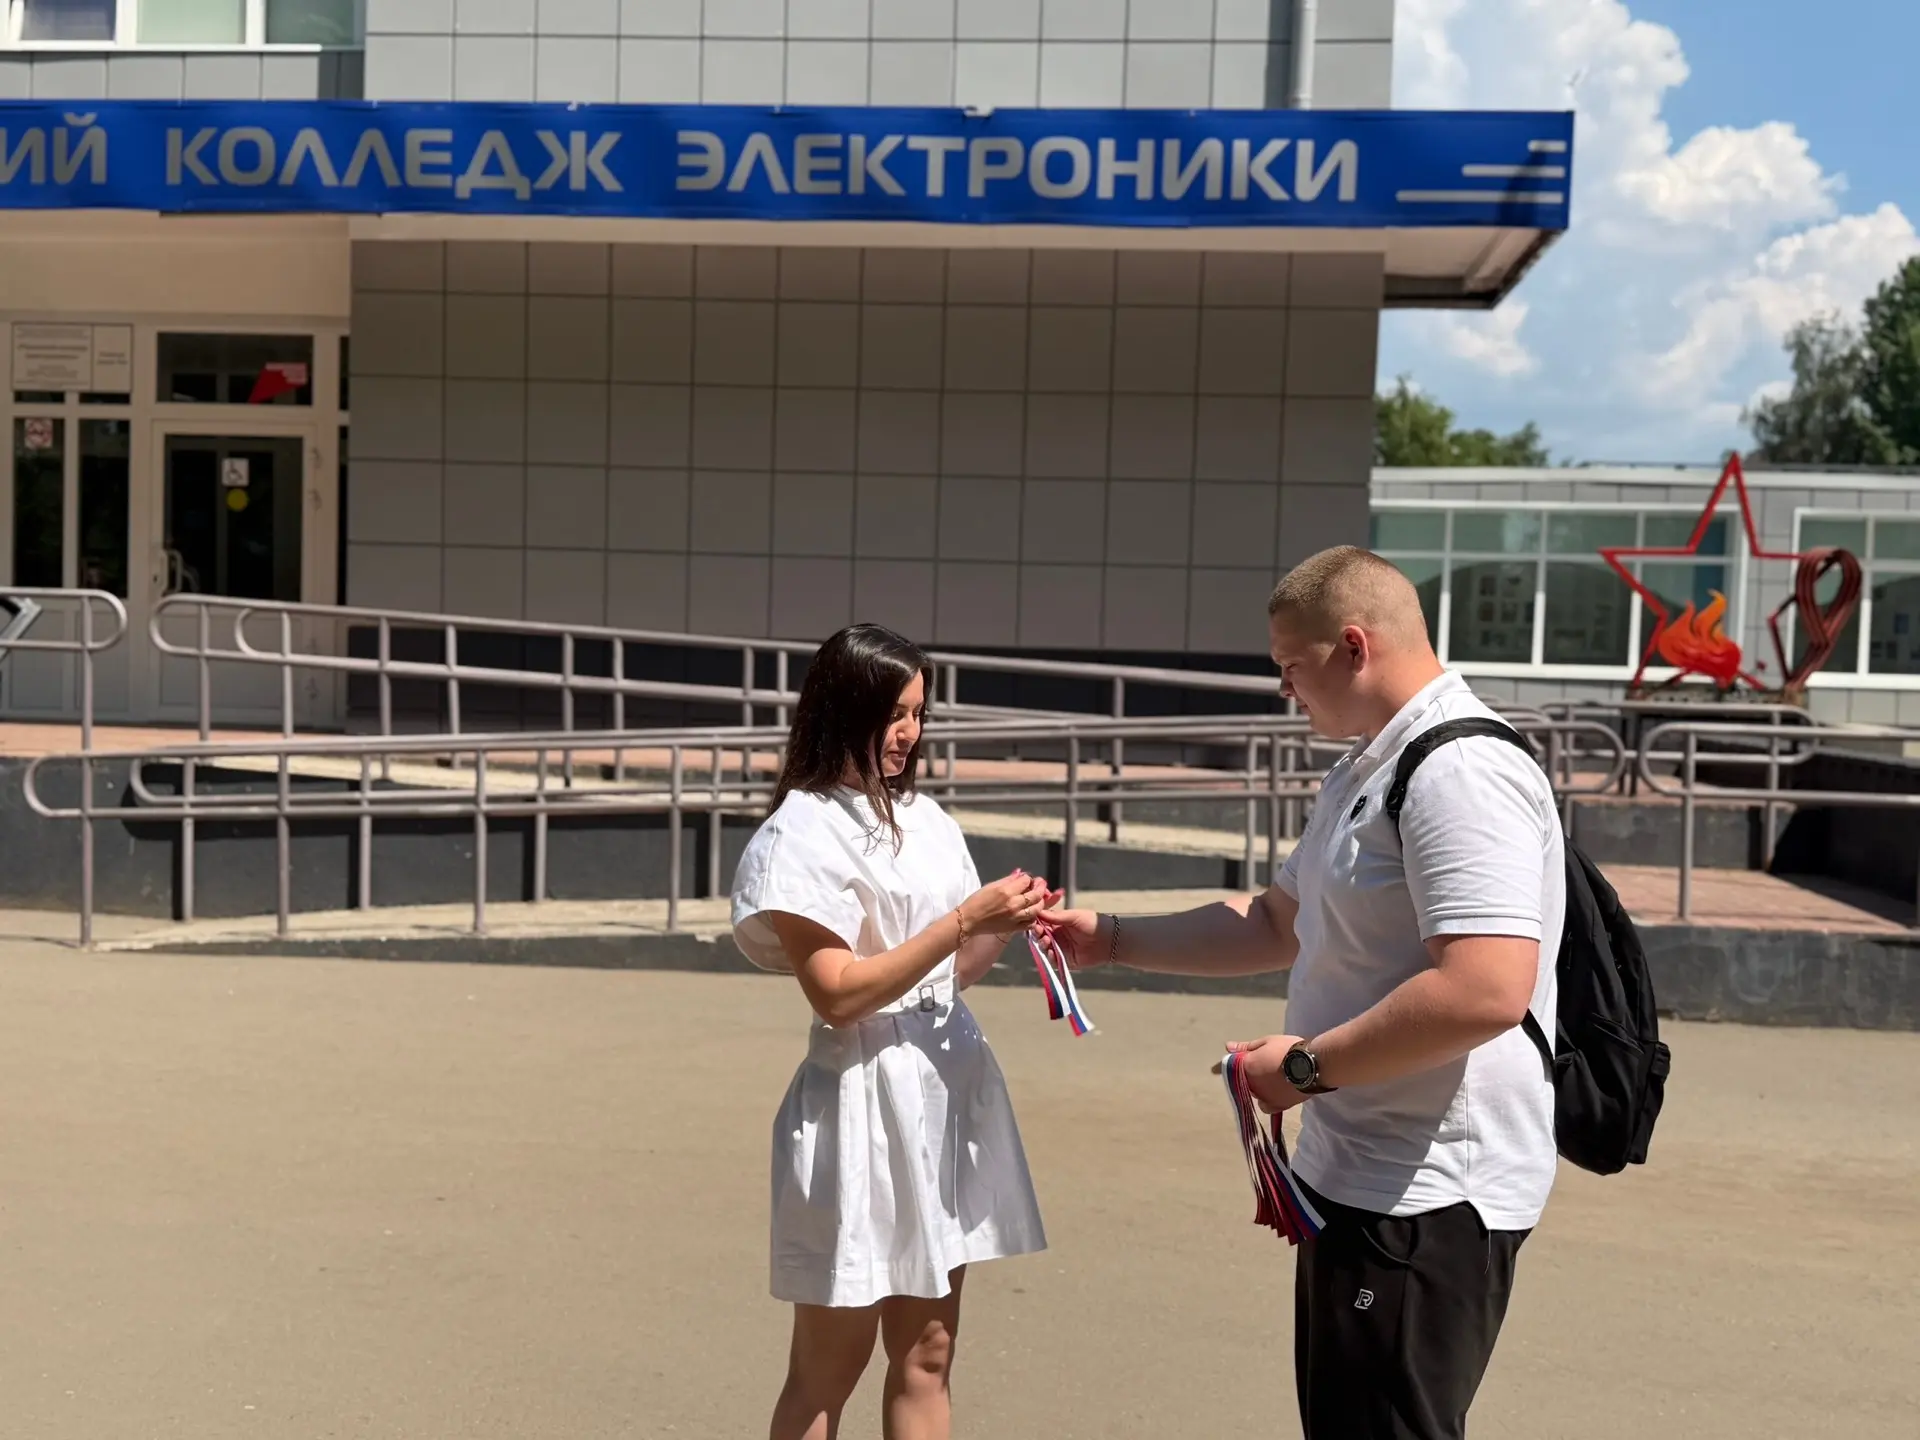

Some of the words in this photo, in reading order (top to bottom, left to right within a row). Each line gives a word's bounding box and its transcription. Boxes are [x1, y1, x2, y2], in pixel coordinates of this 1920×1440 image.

[0, 112, 108, 186] ИЙ
[165, 127, 624, 200] КОЛЛЕДЖ
[675, 130, 1359, 202] ЭЛЕКТРОНИКИ
